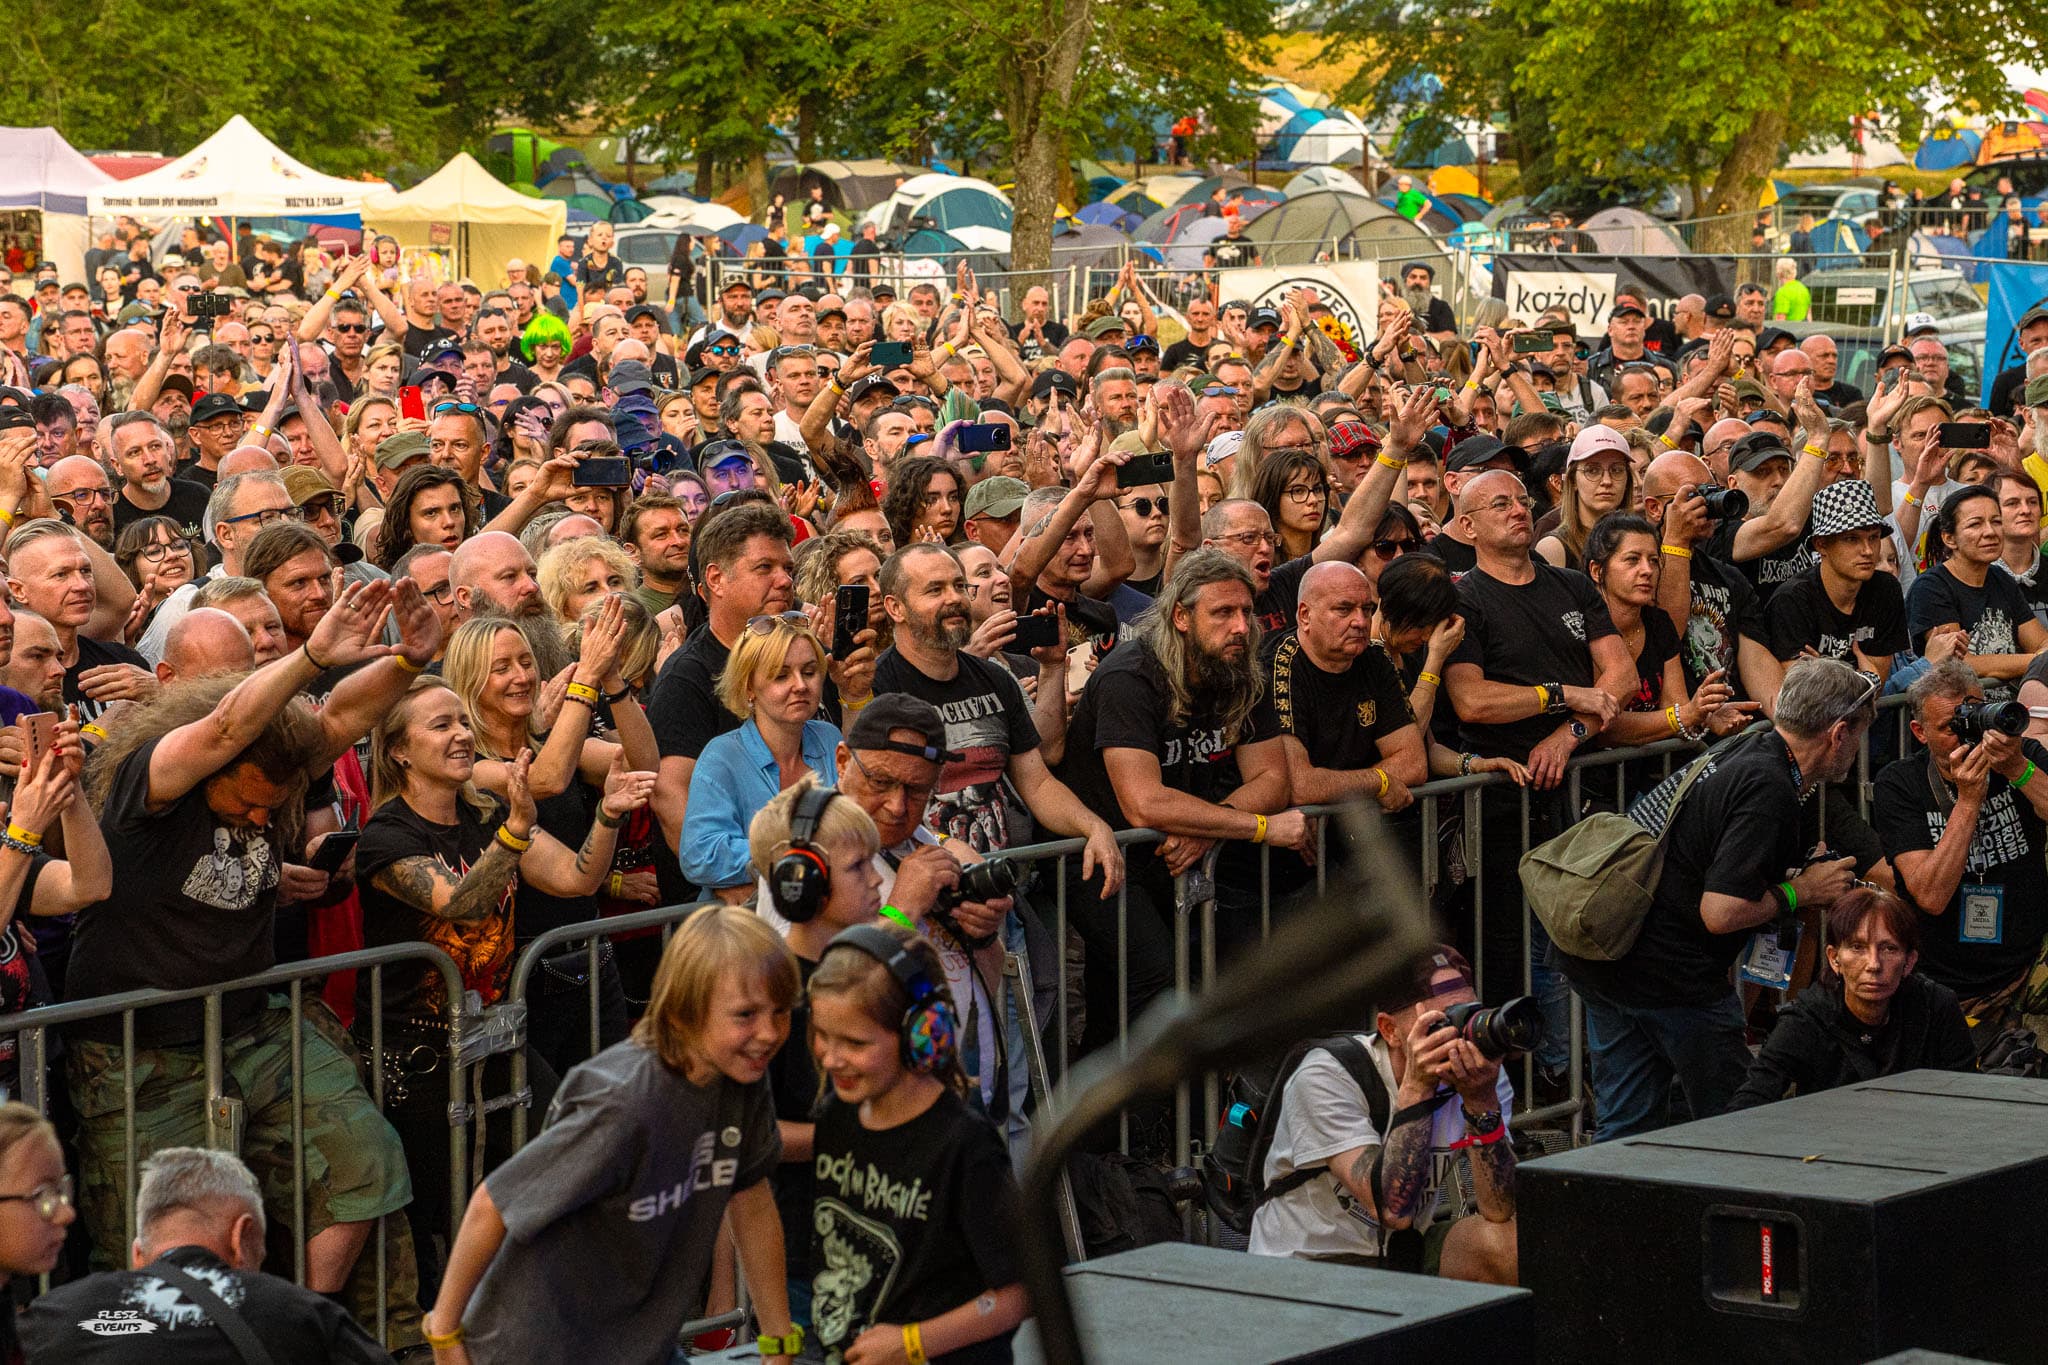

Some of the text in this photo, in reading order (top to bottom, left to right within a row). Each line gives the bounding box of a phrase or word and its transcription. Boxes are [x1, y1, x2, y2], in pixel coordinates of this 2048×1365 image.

[1516, 284, 1607, 325] każdy
[2001, 825, 2019, 860] BOND
[1762, 1235, 1772, 1267] AUDIO
[1763, 1275, 1773, 1294] POL
